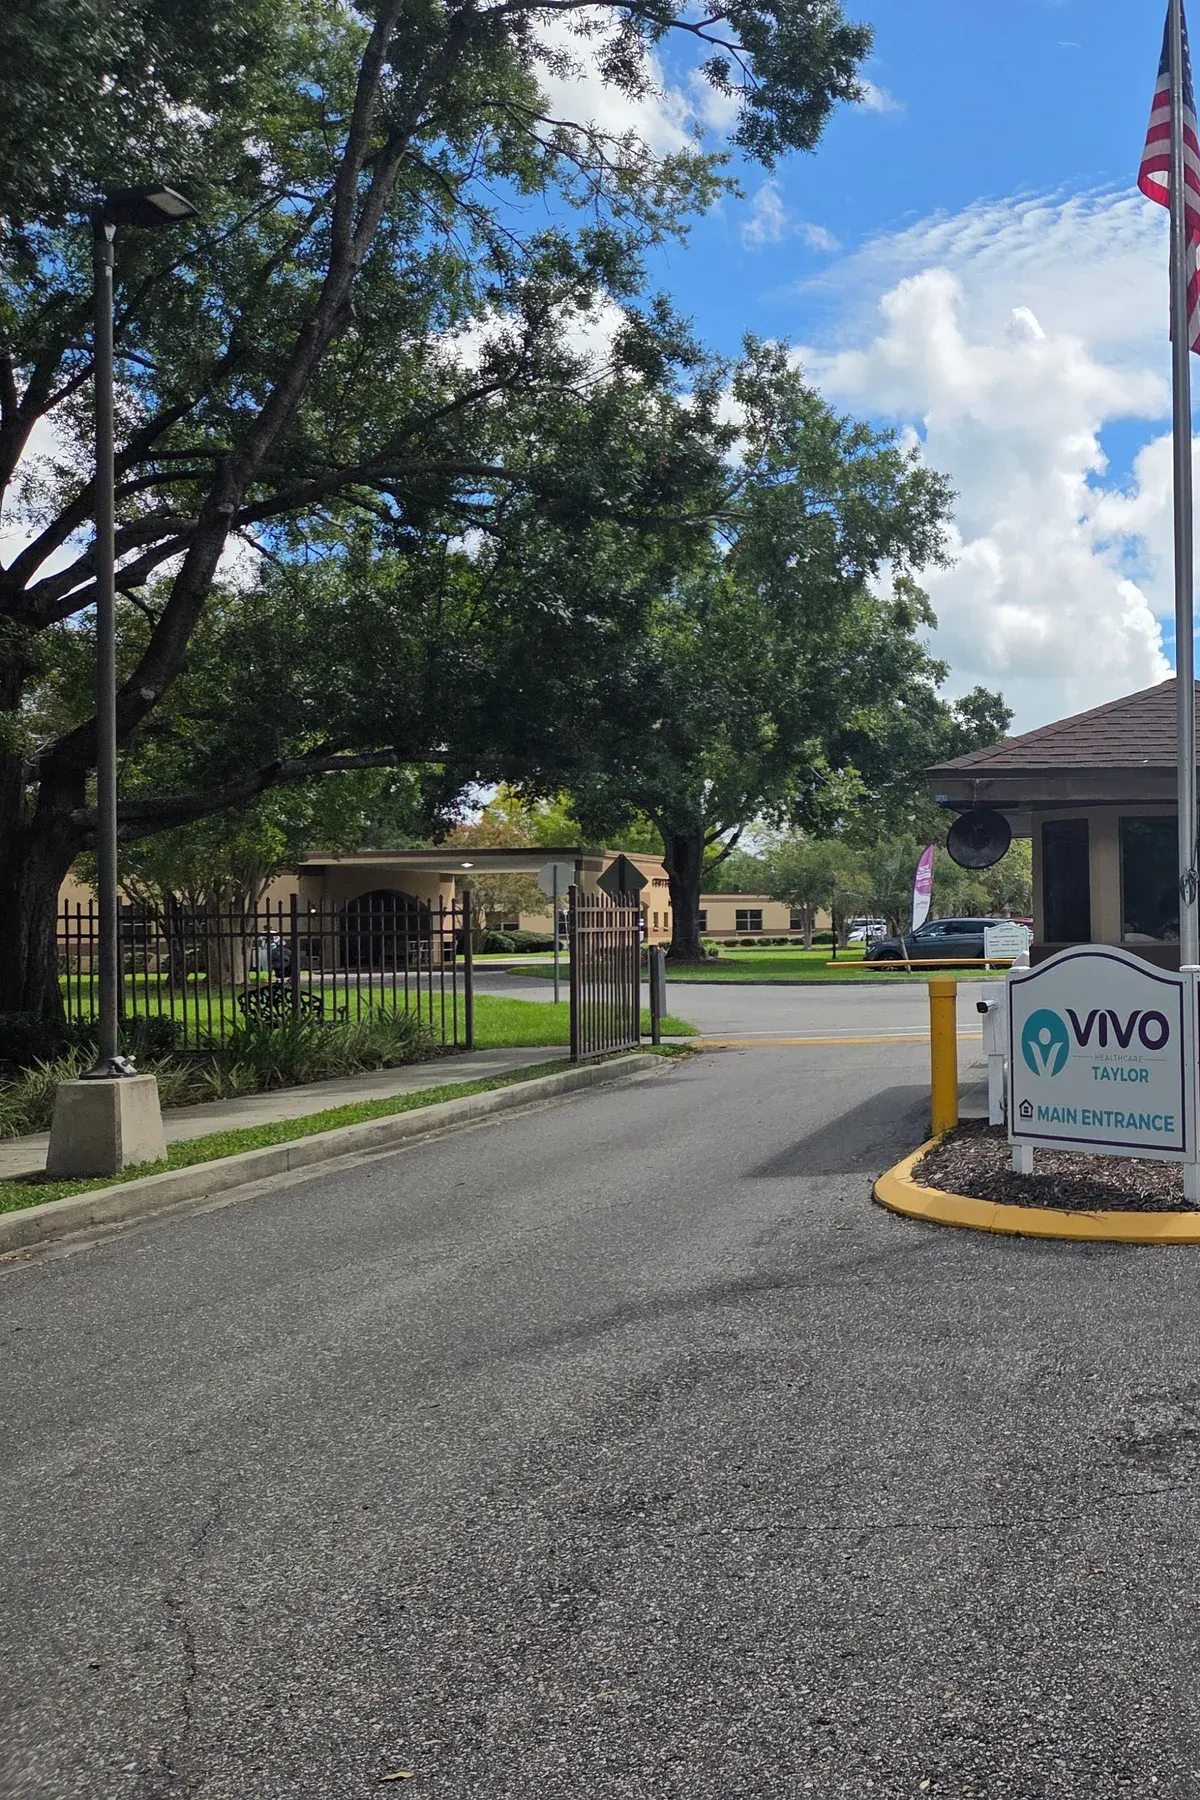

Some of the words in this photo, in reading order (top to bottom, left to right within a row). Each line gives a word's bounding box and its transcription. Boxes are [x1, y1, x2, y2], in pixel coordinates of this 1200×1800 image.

[1065, 1008, 1170, 1050] VIVO
[1094, 1054, 1143, 1063] HEALTHCARE
[1092, 1066, 1149, 1083] TAYLOR
[1037, 1105, 1077, 1124] MAIN
[1081, 1109, 1174, 1132] ENTRANCE
